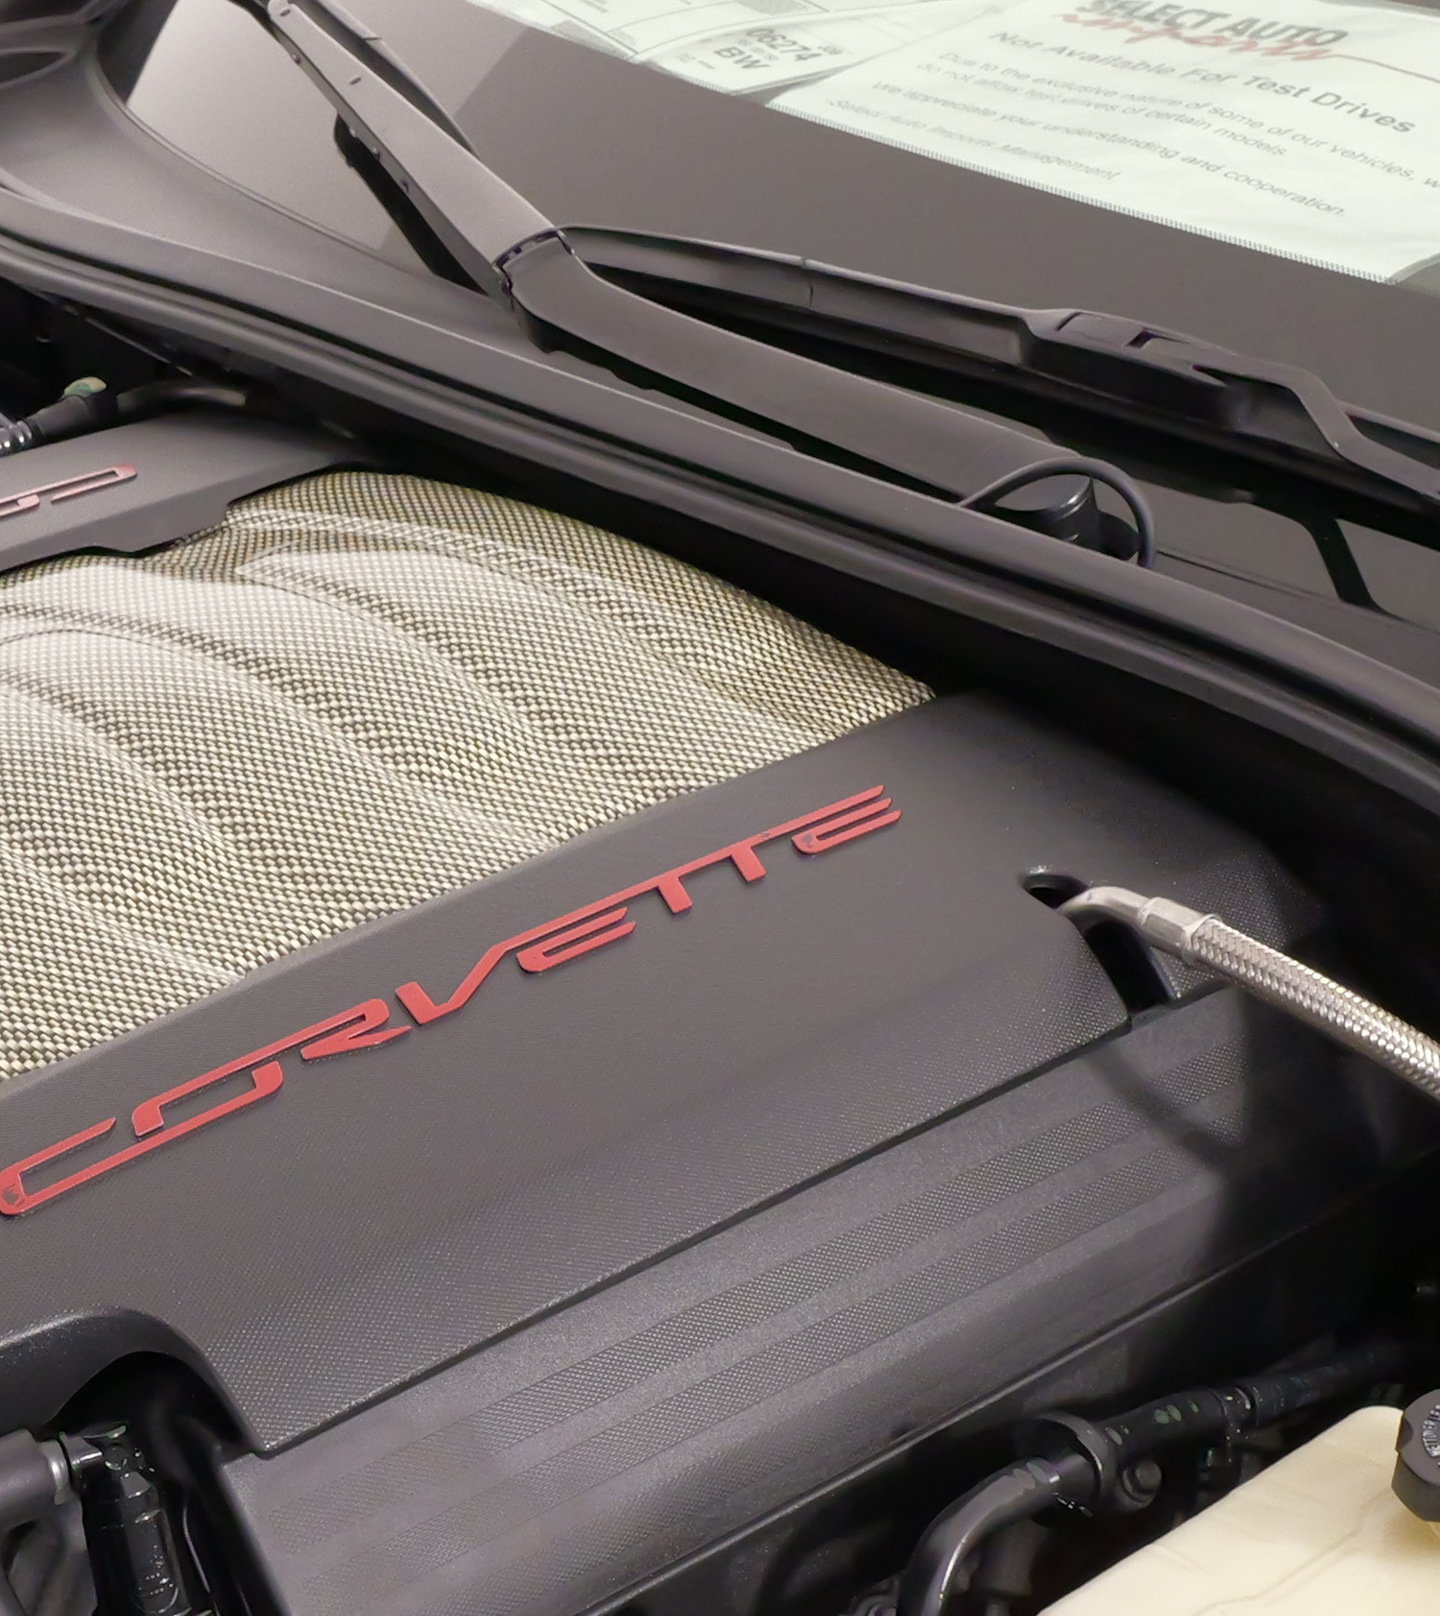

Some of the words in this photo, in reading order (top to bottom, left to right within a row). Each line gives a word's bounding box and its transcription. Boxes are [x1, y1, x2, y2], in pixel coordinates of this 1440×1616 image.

[746, 28, 822, 62] 06274
[1212, 13, 1349, 47] AUTO
[713, 45, 770, 69] BW
[987, 30, 1047, 49] Not
[1040, 43, 1182, 76] Available
[1177, 66, 1239, 83] For
[1237, 74, 1316, 98] Test
[1307, 91, 1423, 133] Drives
[975, 62, 1002, 72] to
[1182, 99, 1214, 112] of
[1208, 105, 1267, 129] some
[1262, 123, 1296, 136] of
[1288, 132, 1331, 148] our
[1325, 144, 1423, 180] vehicles,
[1119, 104, 1149, 116] of
[1140, 108, 1219, 129] certain
[1213, 126, 1294, 157] models.
[898, 89, 1001, 118] appreciate
[992, 112, 1045, 128] your
[1039, 123, 1184, 160] understanding
[1177, 154, 1227, 173] and
[1217, 169, 1356, 216] cooperation.
